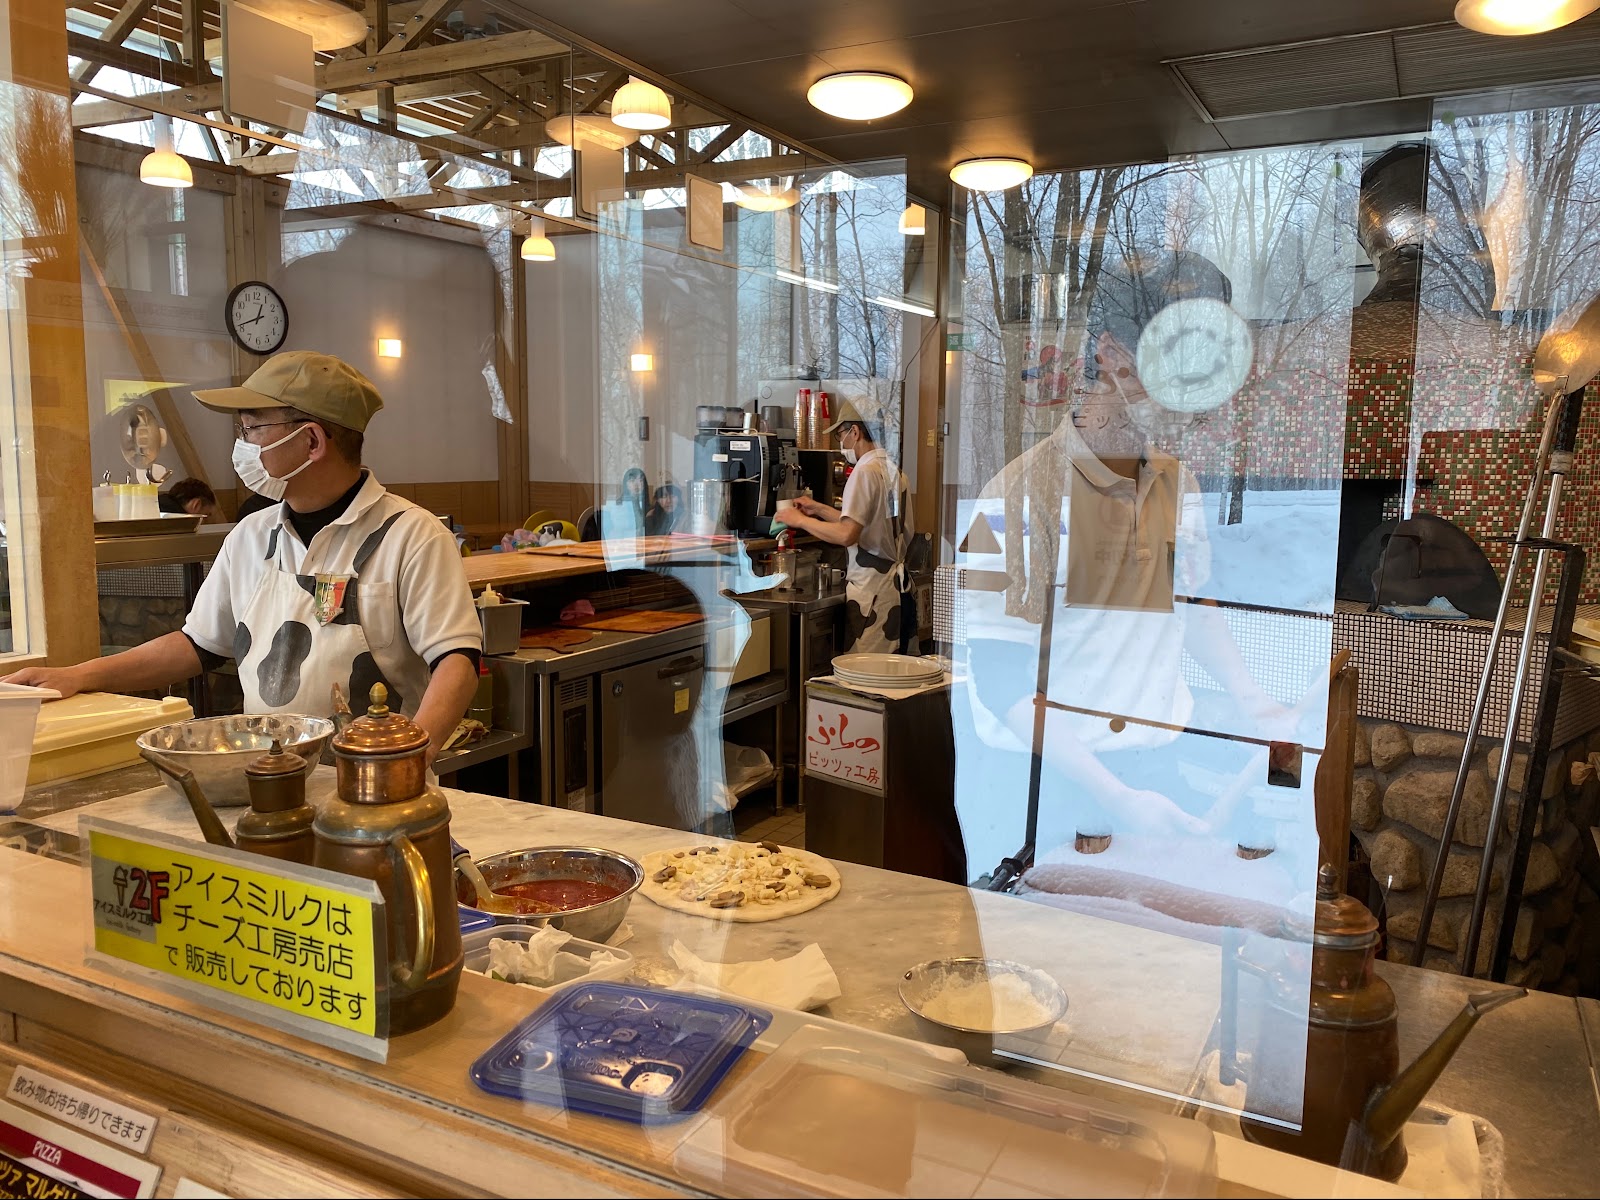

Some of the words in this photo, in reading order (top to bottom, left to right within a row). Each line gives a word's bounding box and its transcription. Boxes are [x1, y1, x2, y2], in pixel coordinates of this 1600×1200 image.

[245, 293, 251, 302] 11
[253, 291, 261, 301] 12
[237, 301, 245, 310] 10
[270, 304, 276, 313] 2
[235, 311, 241, 321] 9
[274, 316, 279, 325] 3
[240, 324, 245, 333] 8
[247, 333, 252, 342] 7
[255, 336, 261, 345] 6
[264, 334, 270, 343] 5
[808, 713, 880, 754] ふらの
[130, 867, 170, 924] 2F
[172, 862, 353, 936] アイスミルクは
[173, 904, 353, 980] チーズ工房売店
[13, 1075, 147, 1142] 飲み物お持ち帰りできます
[32, 1140, 62, 1165] PIZZA
